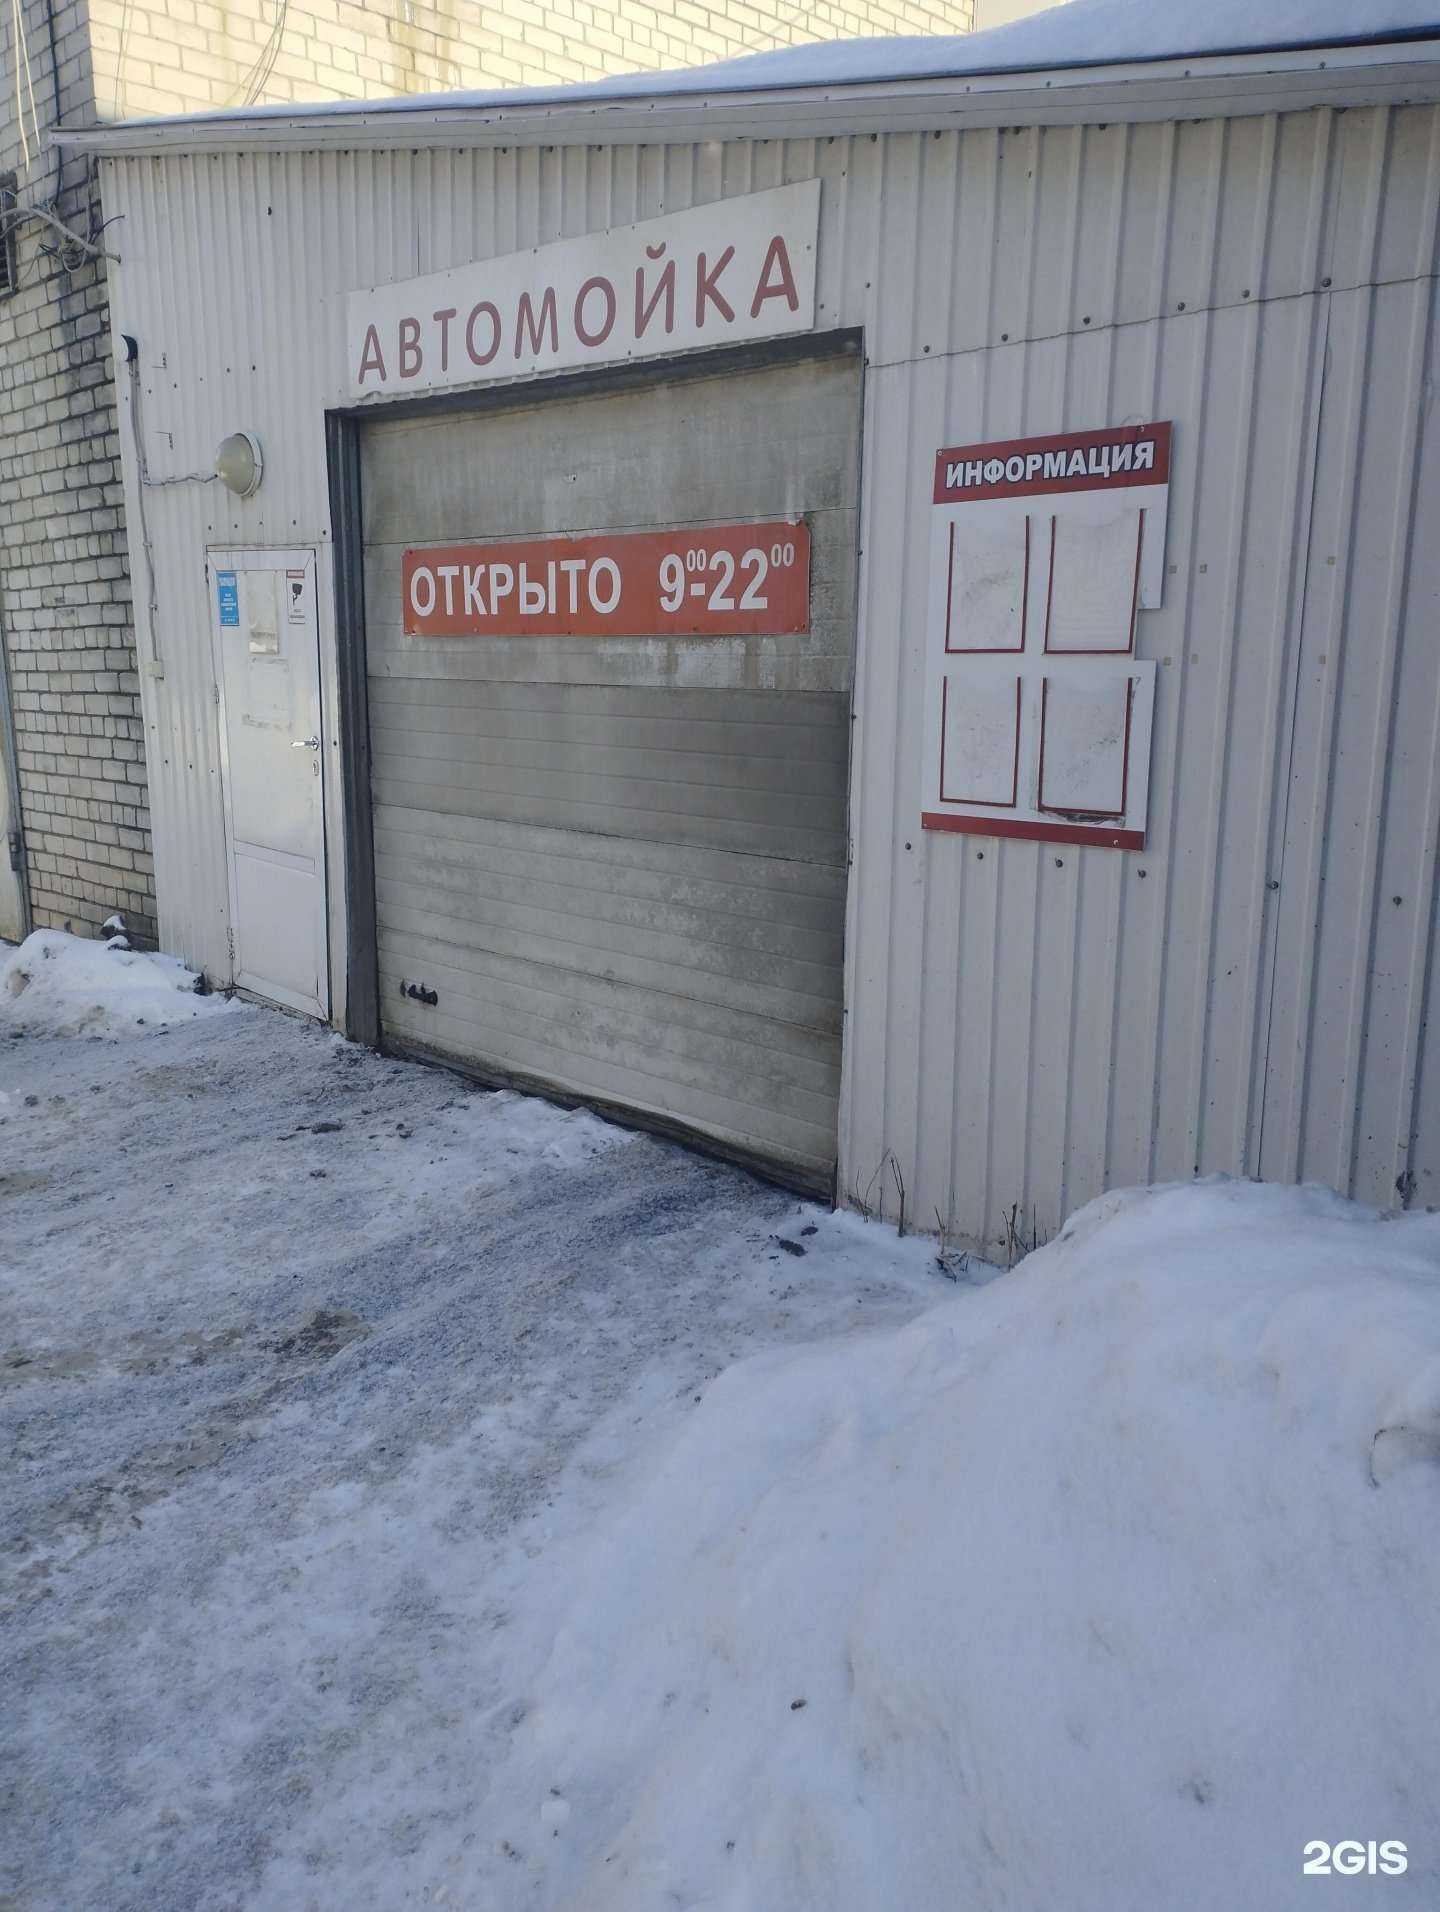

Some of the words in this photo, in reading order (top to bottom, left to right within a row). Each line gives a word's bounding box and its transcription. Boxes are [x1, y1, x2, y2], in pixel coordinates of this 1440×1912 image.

[358, 235, 799, 385] АВТОМОЙКА
[946, 441, 1154, 488] ИНФОРМАЦИЯ
[410, 557, 622, 617] ОТКРЫТО
